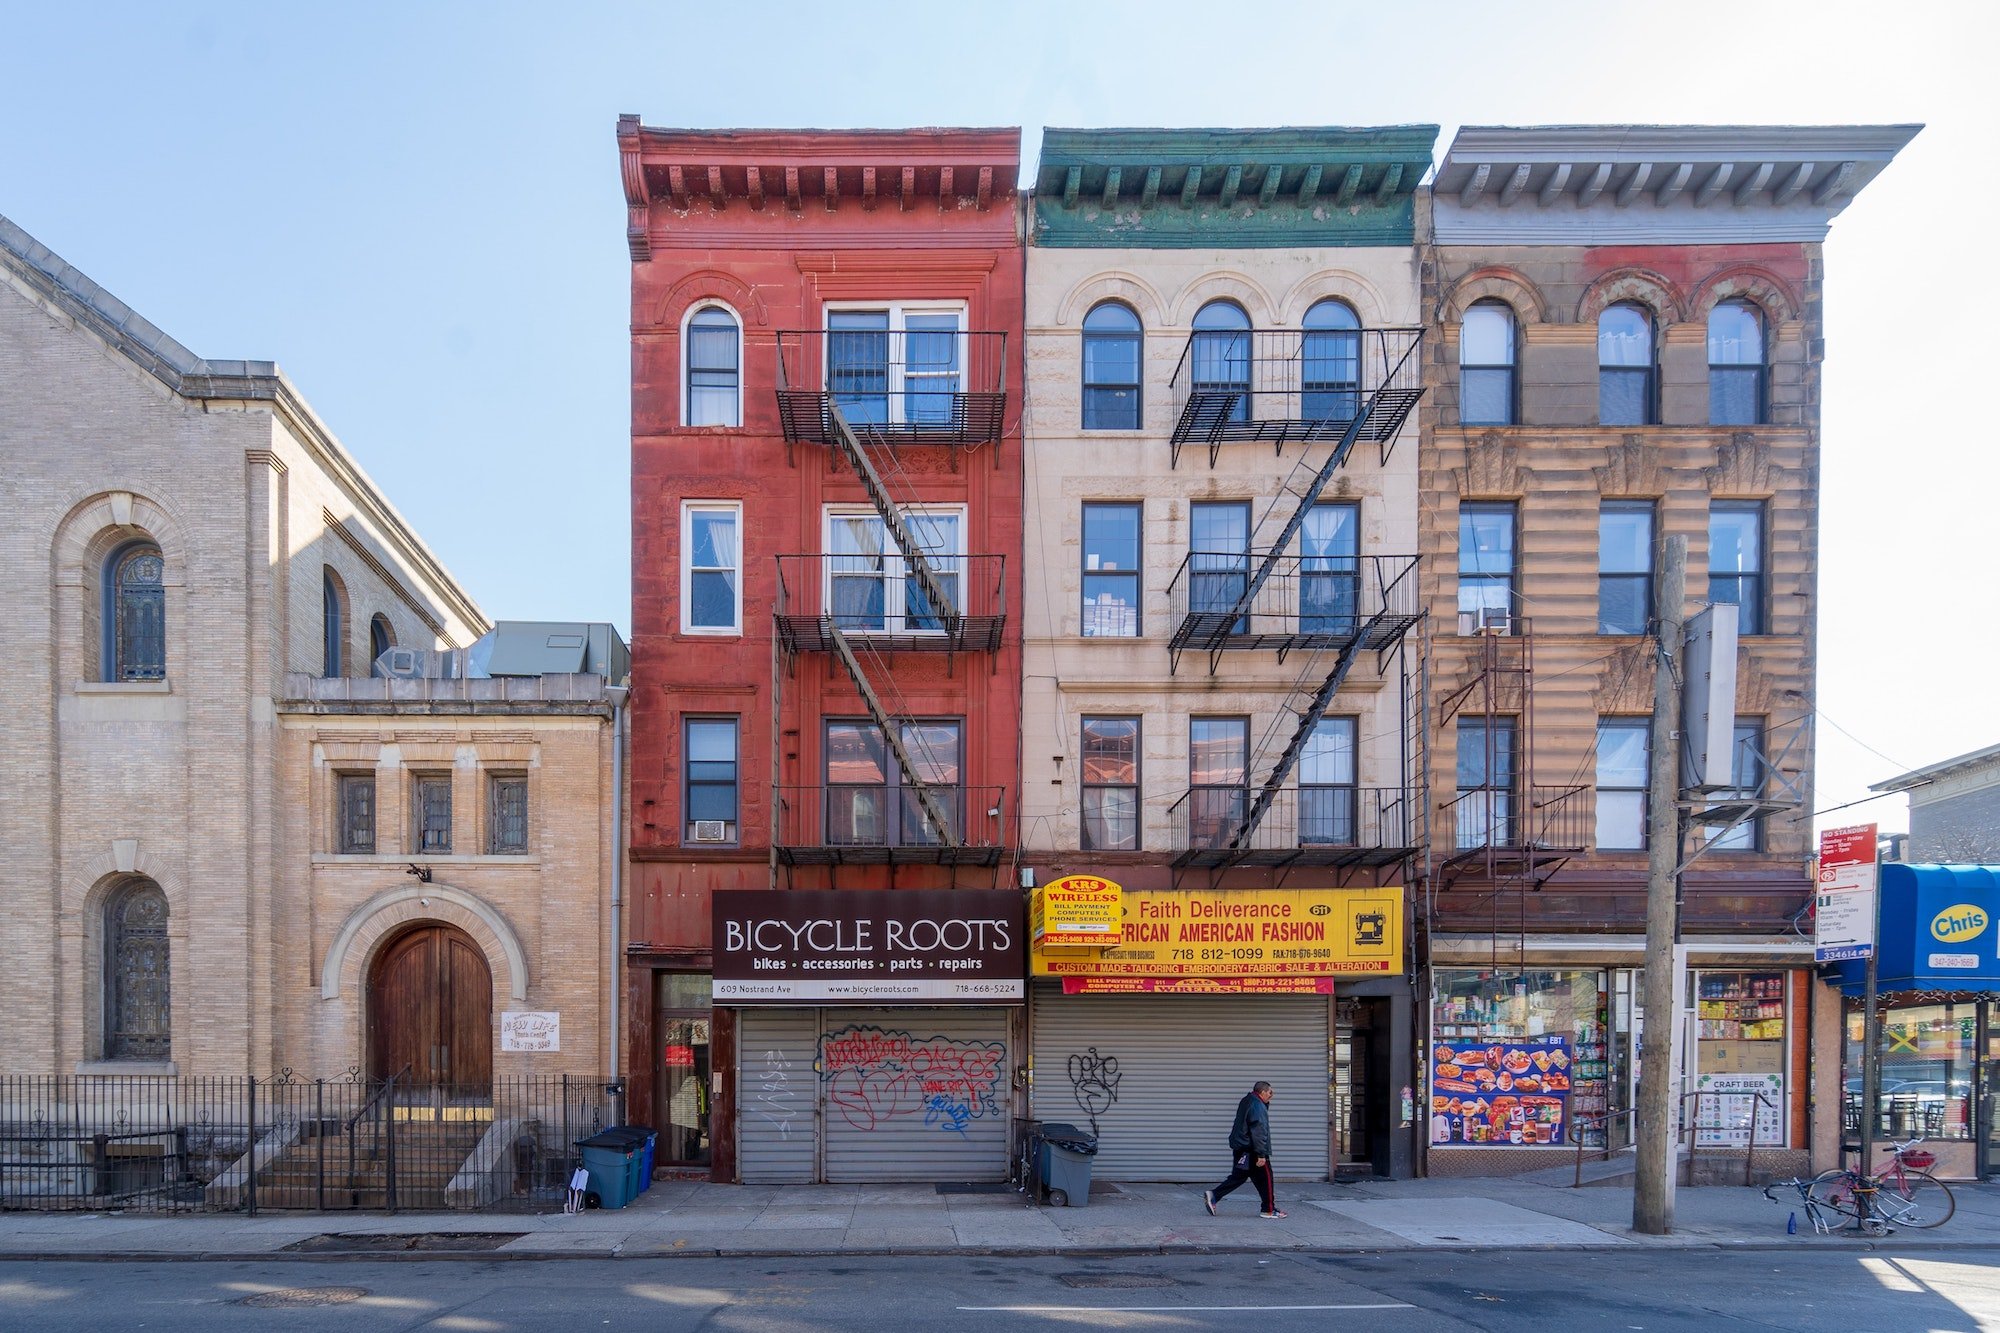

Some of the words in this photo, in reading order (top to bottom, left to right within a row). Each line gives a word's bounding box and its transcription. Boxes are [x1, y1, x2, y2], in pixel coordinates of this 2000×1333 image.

[1834, 826, 1869, 836] STANDING
[1068, 880, 1099, 889] KRS
[1048, 893, 1118, 902] WIRELESS
[1140, 901, 1181, 918] Faith
[1190, 901, 1291, 918] Deliverance
[1312, 906, 1329, 915] 611
[1935, 911, 1984, 937] Chris
[726, 919, 873, 952] BICYCLE
[886, 919, 1010, 952] ROOTS
[1179, 923, 1254, 942] AMERICAN
[1262, 922, 1325, 942] FASHION
[1171, 949, 1194, 960] 718
[1201, 948, 1263, 960] 812-1099
[1823, 950, 1857, 959] 334614
[753, 957, 787, 970] bikes
[803, 957, 874, 970] accessories
[890, 957, 923, 972] parts
[939, 957, 982, 972] repairs
[1056, 963, 1096, 972] CUSTOM
[1099, 964, 1129, 973] MADE
[1131, 964, 1179, 973] TAILORING
[1184, 964, 1243, 973] EMBROIDERY
[1248, 963, 1281, 972] FABRIC
[1286, 962, 1309, 971] SALE
[1313, 962, 1321, 971] &
[1325, 961, 1382, 971] ALTERATION
[721, 985, 737, 994] 609
[740, 985, 774, 994] Nostrand
[776, 985, 791, 994] Ave
[828, 985, 919, 996] www.bicycleroots.com
[956, 985, 1015, 994] 718-668-5224
[504, 1020, 529, 1032] NEW
[531, 1020, 558, 1033] LIFE
[1550, 1036, 1563, 1045] EBT
